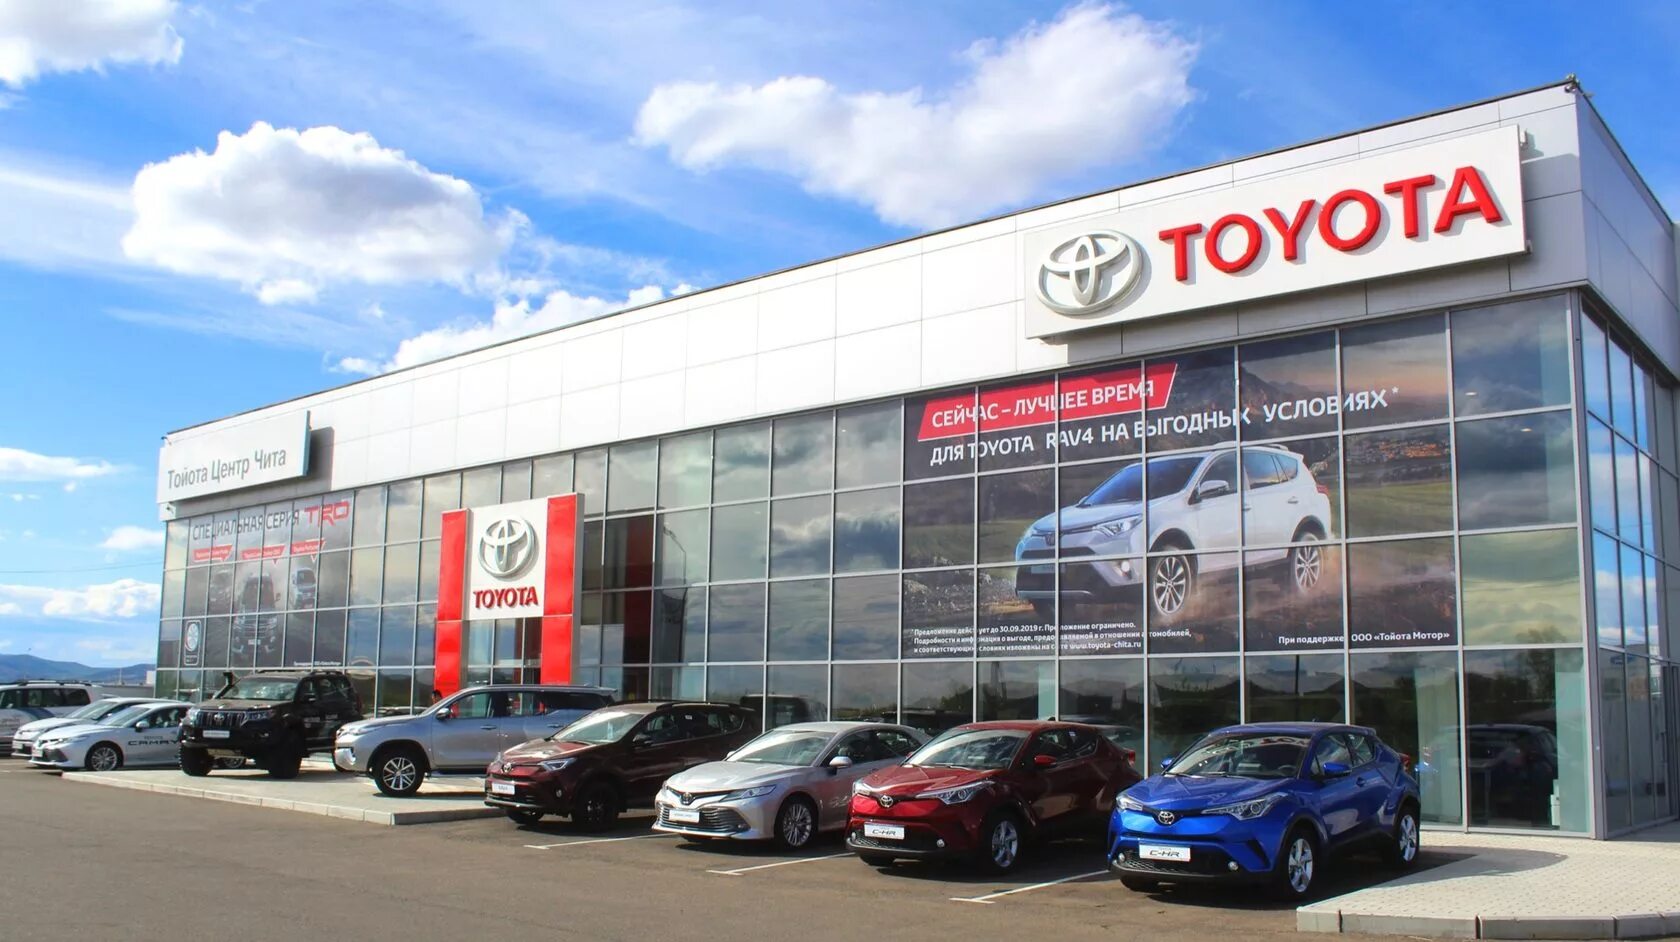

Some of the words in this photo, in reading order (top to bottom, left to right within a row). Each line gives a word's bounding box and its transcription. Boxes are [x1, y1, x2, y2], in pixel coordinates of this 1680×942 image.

[1159, 165, 1503, 282] TOYOTA
[931, 403, 998, 428] СЕЙЧАС
[1014, 389, 1088, 416] ЛУЧШЕЕ
[1092, 380, 1154, 405] ВРЕМЯ
[930, 444, 964, 466] ДЛЯ
[967, 435, 1034, 459] TOYOTA
[1046, 428, 1094, 449] RAV4
[1101, 423, 1129, 442] НА
[1134, 406, 1251, 438] ВЫГОДНЫХ
[168, 467, 208, 489] Тойота
[211, 458, 250, 483] Центр
[254, 449, 287, 470] Чита
[192, 516, 264, 541] СПЕЦИАЛЬНАЯ
[265, 509, 300, 530] СЕРИЯ
[304, 501, 350, 527] TRD
[473, 586, 539, 609] TOYOTA
[913, 637, 956, 646] Подробности
[961, 636, 1001, 644] инфмация
[1033, 632, 1094, 642] предоавляемой
[1141, 629, 1192, 640] атомобилей,
[957, 625, 990, 635] дейсует
[999, 624, 1038, 633] 30.09.2019
[1044, 623, 1090, 633] Преложение
[1091, 622, 1136, 631] ограничено.
[1278, 636, 1295, 645] При
[1296, 634, 1344, 645] поддержке
[1350, 633, 1372, 642] ООО
[1373, 631, 1411, 641] «Тойота
[1412, 630, 1450, 640] Мотор»
[1069, 640, 1142, 651] www.toyota-chita.ru
